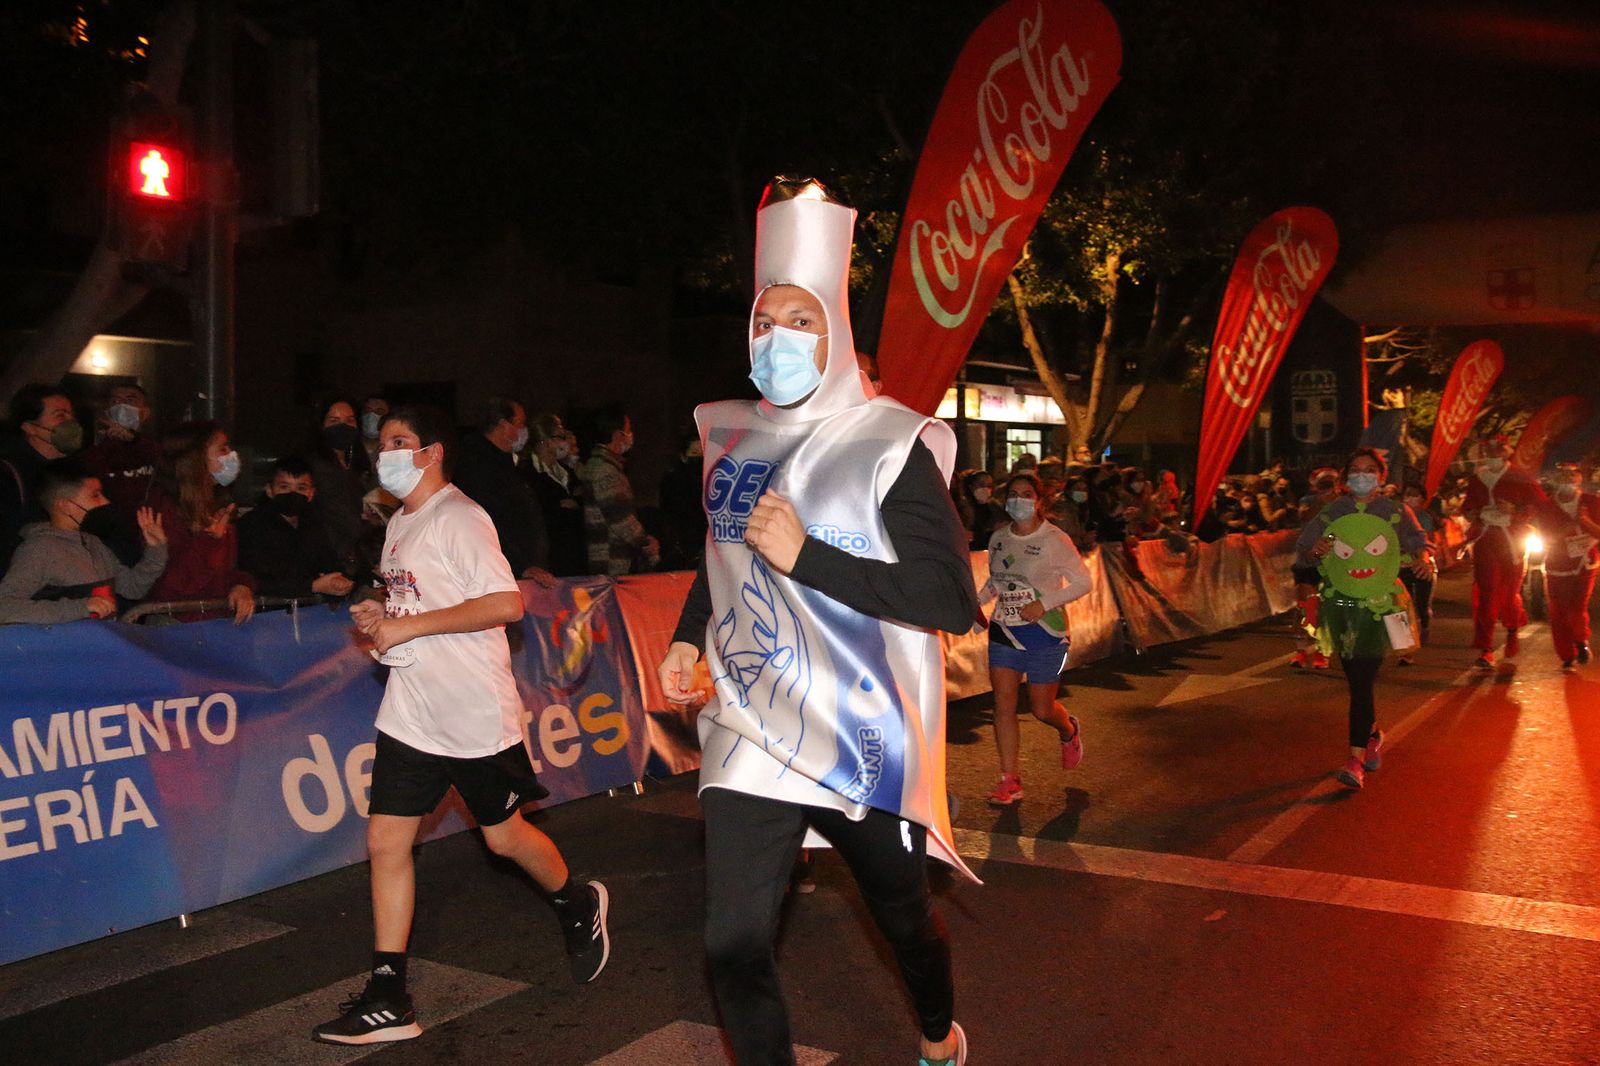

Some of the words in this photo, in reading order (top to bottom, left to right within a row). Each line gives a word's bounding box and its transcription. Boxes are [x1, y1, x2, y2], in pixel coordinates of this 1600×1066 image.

[910, 2, 1089, 329] Coca-Cola
[1218, 217, 1321, 409] Coca-Cola
[0, 770, 159, 861] ERÍA
